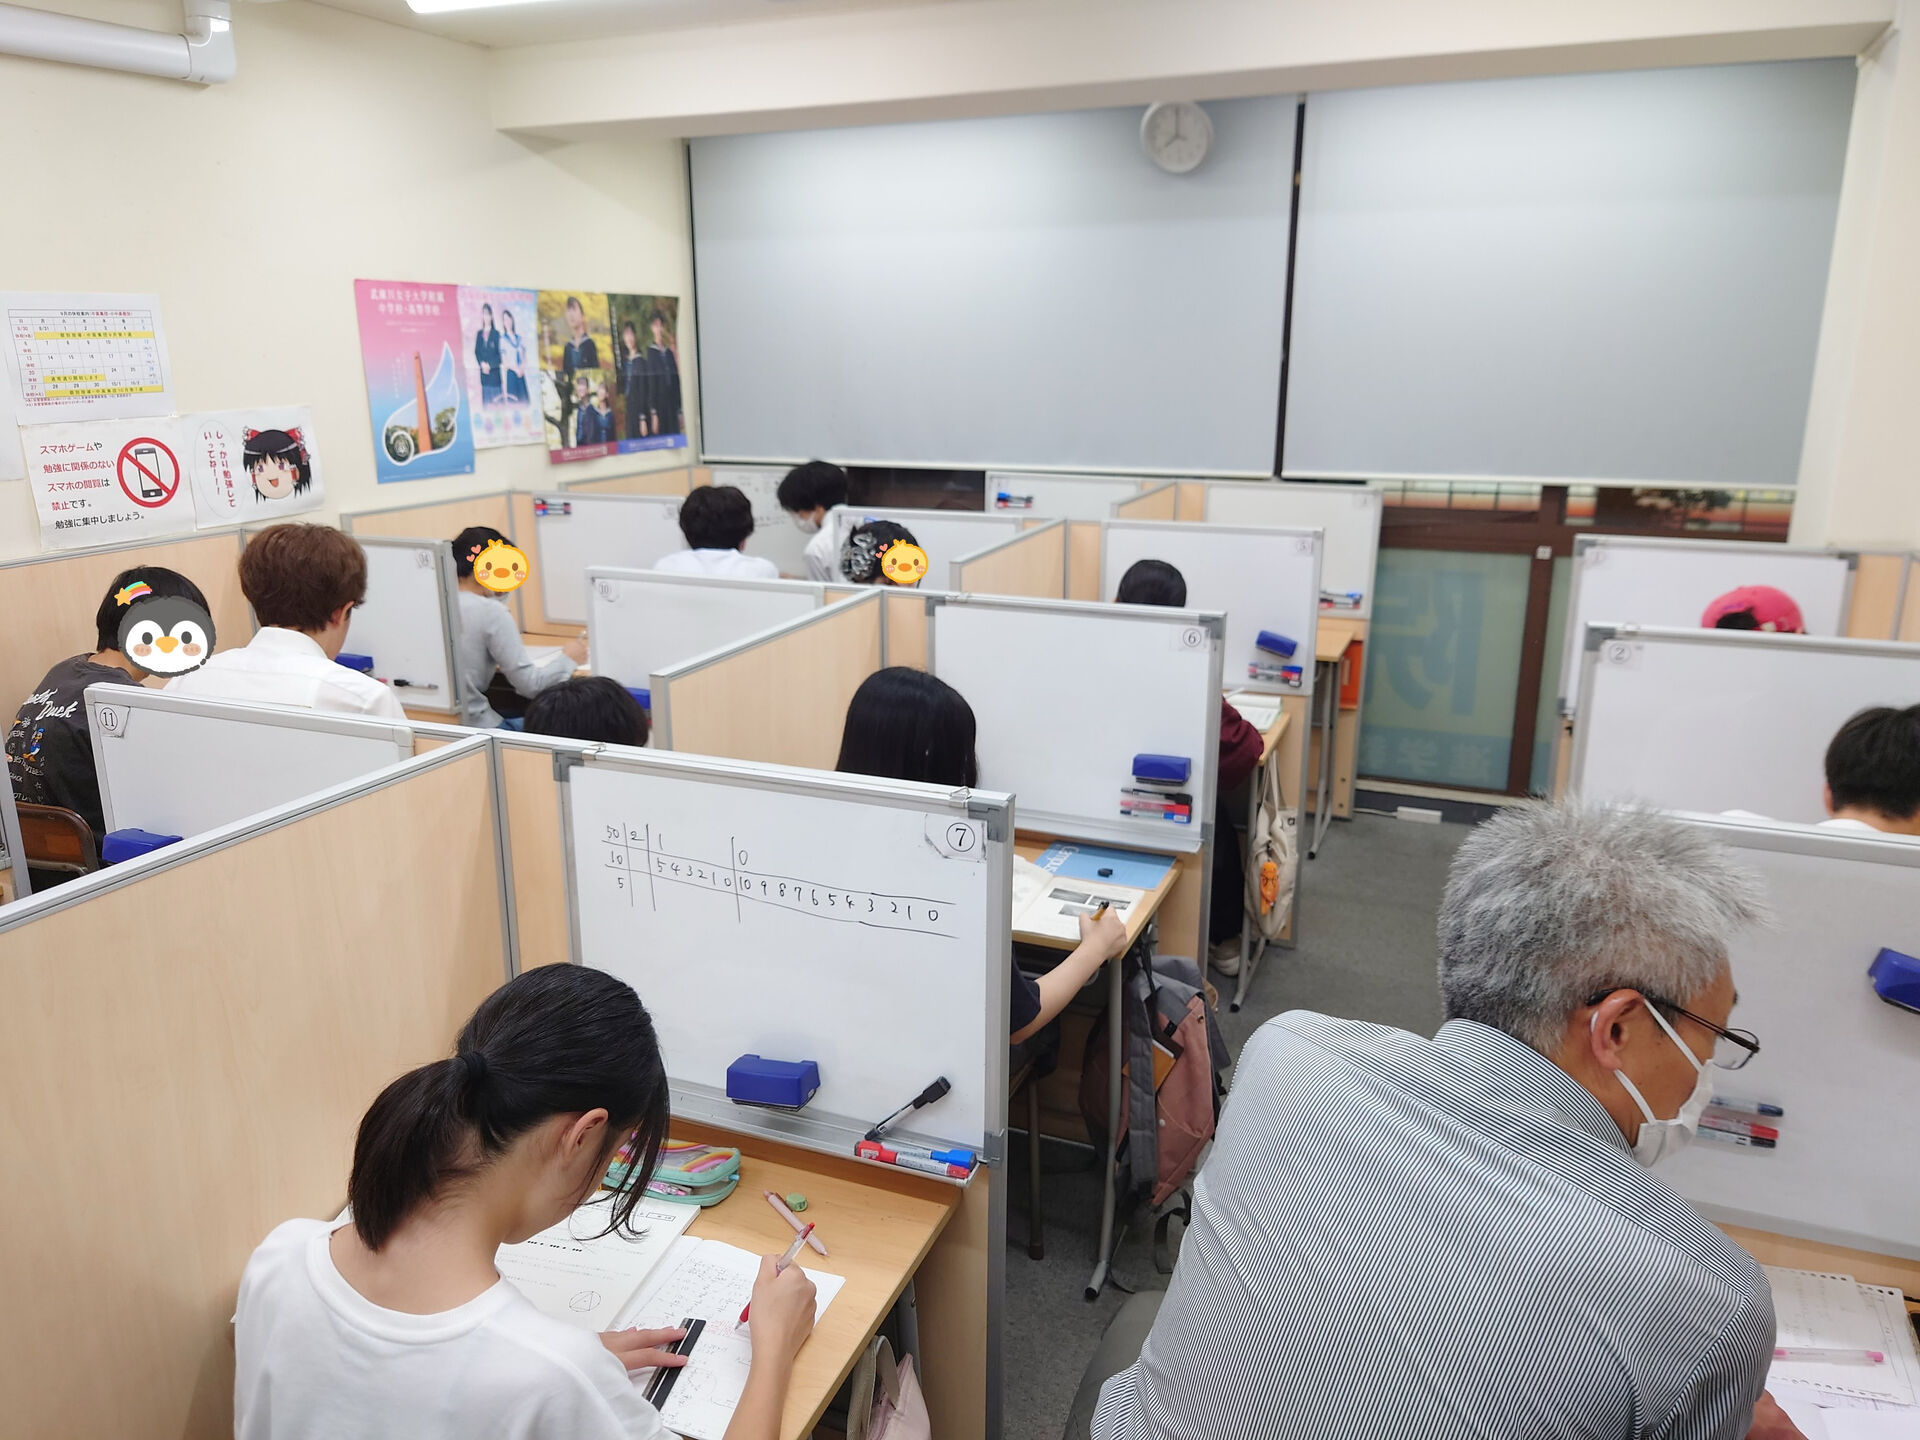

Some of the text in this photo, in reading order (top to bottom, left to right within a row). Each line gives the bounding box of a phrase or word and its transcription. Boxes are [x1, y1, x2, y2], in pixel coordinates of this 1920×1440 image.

[40, 442, 102, 454] スマホゲームや
[44, 459, 114, 474] 勉強に関係のない
[216, 431, 236, 508] しっかり勉強して
[47, 479, 110, 493] スマホの閲覧は
[52, 499, 93, 512] 禁止です。
[55, 512, 145, 530] 勉強に集中しましょう。
[35, 701, 79, 721] Duck
[607, 825, 748, 865] 50 2 1 0
[611, 851, 939, 921] 10 5 4 3 2 1 0 10 9 8 7 6 5 4 3 2 1 0
[618, 877, 624, 888] 5
